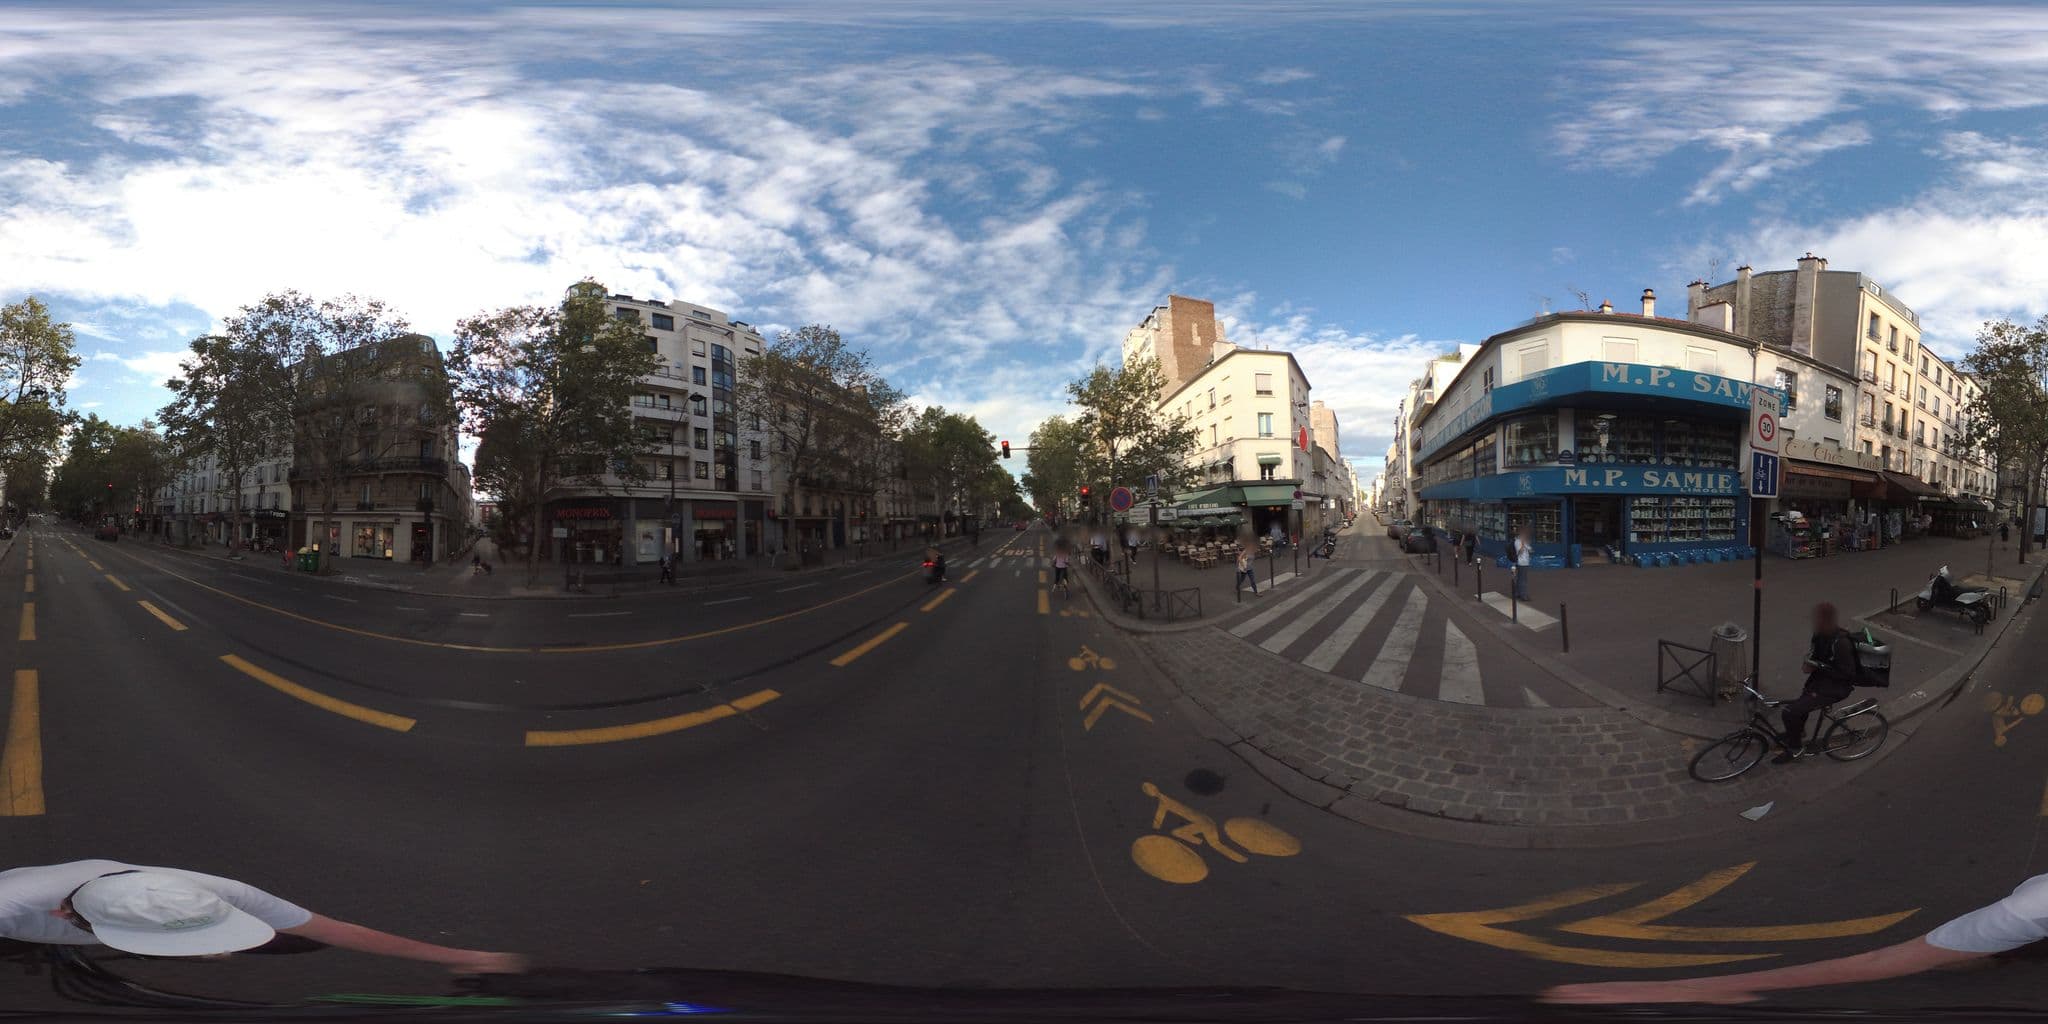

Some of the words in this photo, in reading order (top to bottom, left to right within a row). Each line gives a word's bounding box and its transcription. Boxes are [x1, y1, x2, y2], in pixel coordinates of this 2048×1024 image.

[1603, 363, 1676, 388] M.P.
[1759, 397, 1776, 411] ZONE
[1762, 422, 1771, 433] 30
[1565, 469, 1628, 487] M.P.
[1643, 471, 1732, 489] SAMIE
